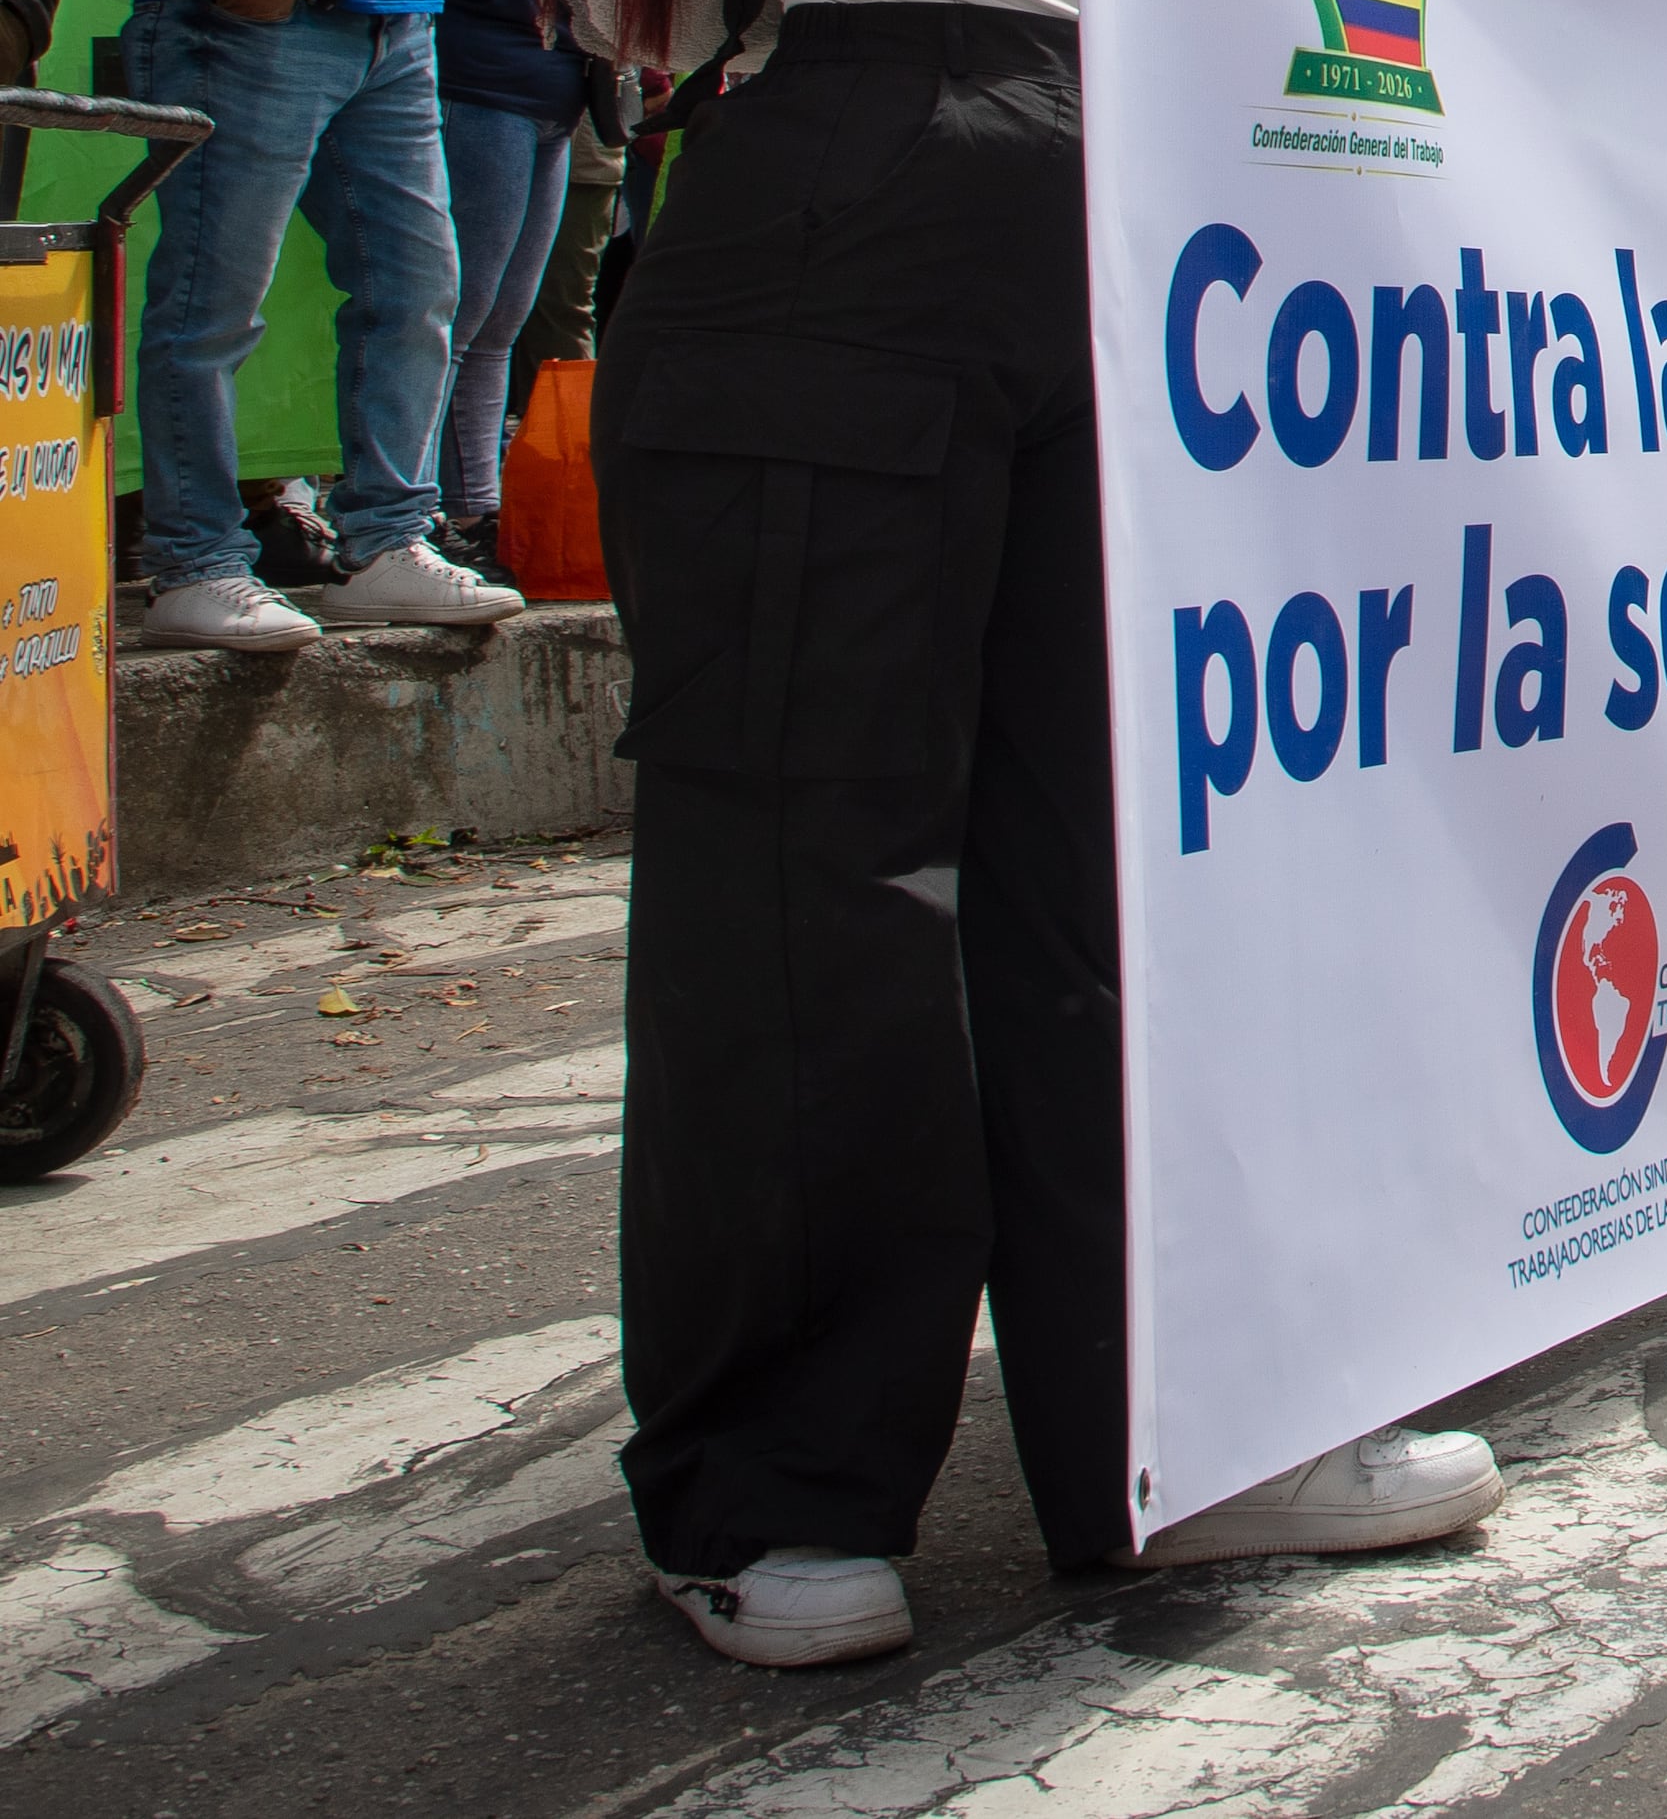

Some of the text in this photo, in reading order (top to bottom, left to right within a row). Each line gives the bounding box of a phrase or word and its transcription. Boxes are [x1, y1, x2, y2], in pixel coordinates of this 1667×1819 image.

[1321, 63, 1361, 91] 1971
[1378, 71, 1413, 99] 2026
[1252, 122, 1443, 167] Confederación General del Trabajo
[1165, 223, 1608, 472] Contra
[1173, 584, 1414, 855] por
[1453, 523, 1568, 753] la
[1523, 1166, 1642, 1240] CONFEDERACIÓN
[1508, 1213, 1633, 1289] TRABAJADORES/AS
[1636, 1205, 1654, 1236] DE
